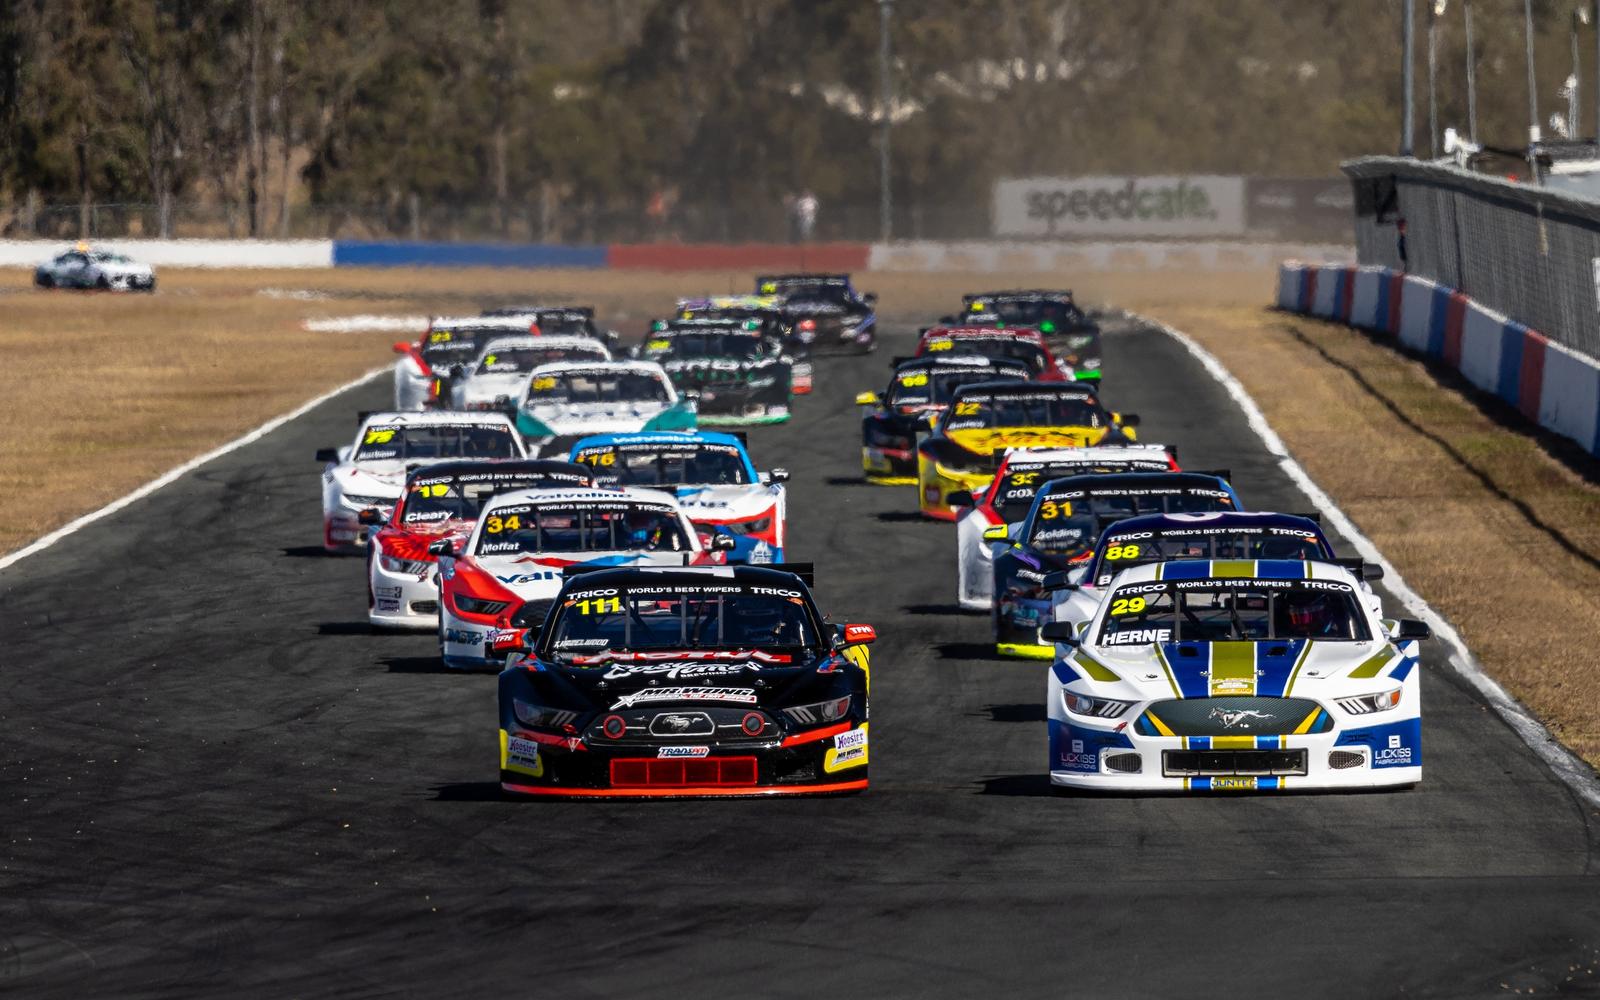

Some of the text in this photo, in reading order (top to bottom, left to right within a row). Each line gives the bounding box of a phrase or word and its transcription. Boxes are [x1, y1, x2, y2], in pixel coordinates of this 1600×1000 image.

[1188, 488, 1229, 498] TRICO
[405, 511, 454, 523] Cleary
[491, 506, 531, 516] TRICO
[537, 503, 574, 511] WORLD'S
[1042, 501, 1073, 520] 31
[487, 515, 521, 534] 34
[1035, 528, 1082, 541] Golding
[1108, 531, 1153, 542] TRICO
[1203, 527, 1226, 535] BEST
[1269, 527, 1316, 538] TRICO
[481, 542, 520, 555] Moffat
[1105, 545, 1140, 560] 88
[566, 588, 618, 600] TRICO
[751, 586, 802, 598] TRICO
[1116, 583, 1168, 596] TRICO
[1176, 580, 1222, 588] WORLD'S
[1253, 580, 1292, 588] WIPERS
[1300, 581, 1352, 592] TRICO
[576, 597, 620, 615] 111
[1111, 597, 1146, 616] 29
[1102, 629, 1171, 645] HERNE
[1375, 747, 1411, 759] LICKISS
